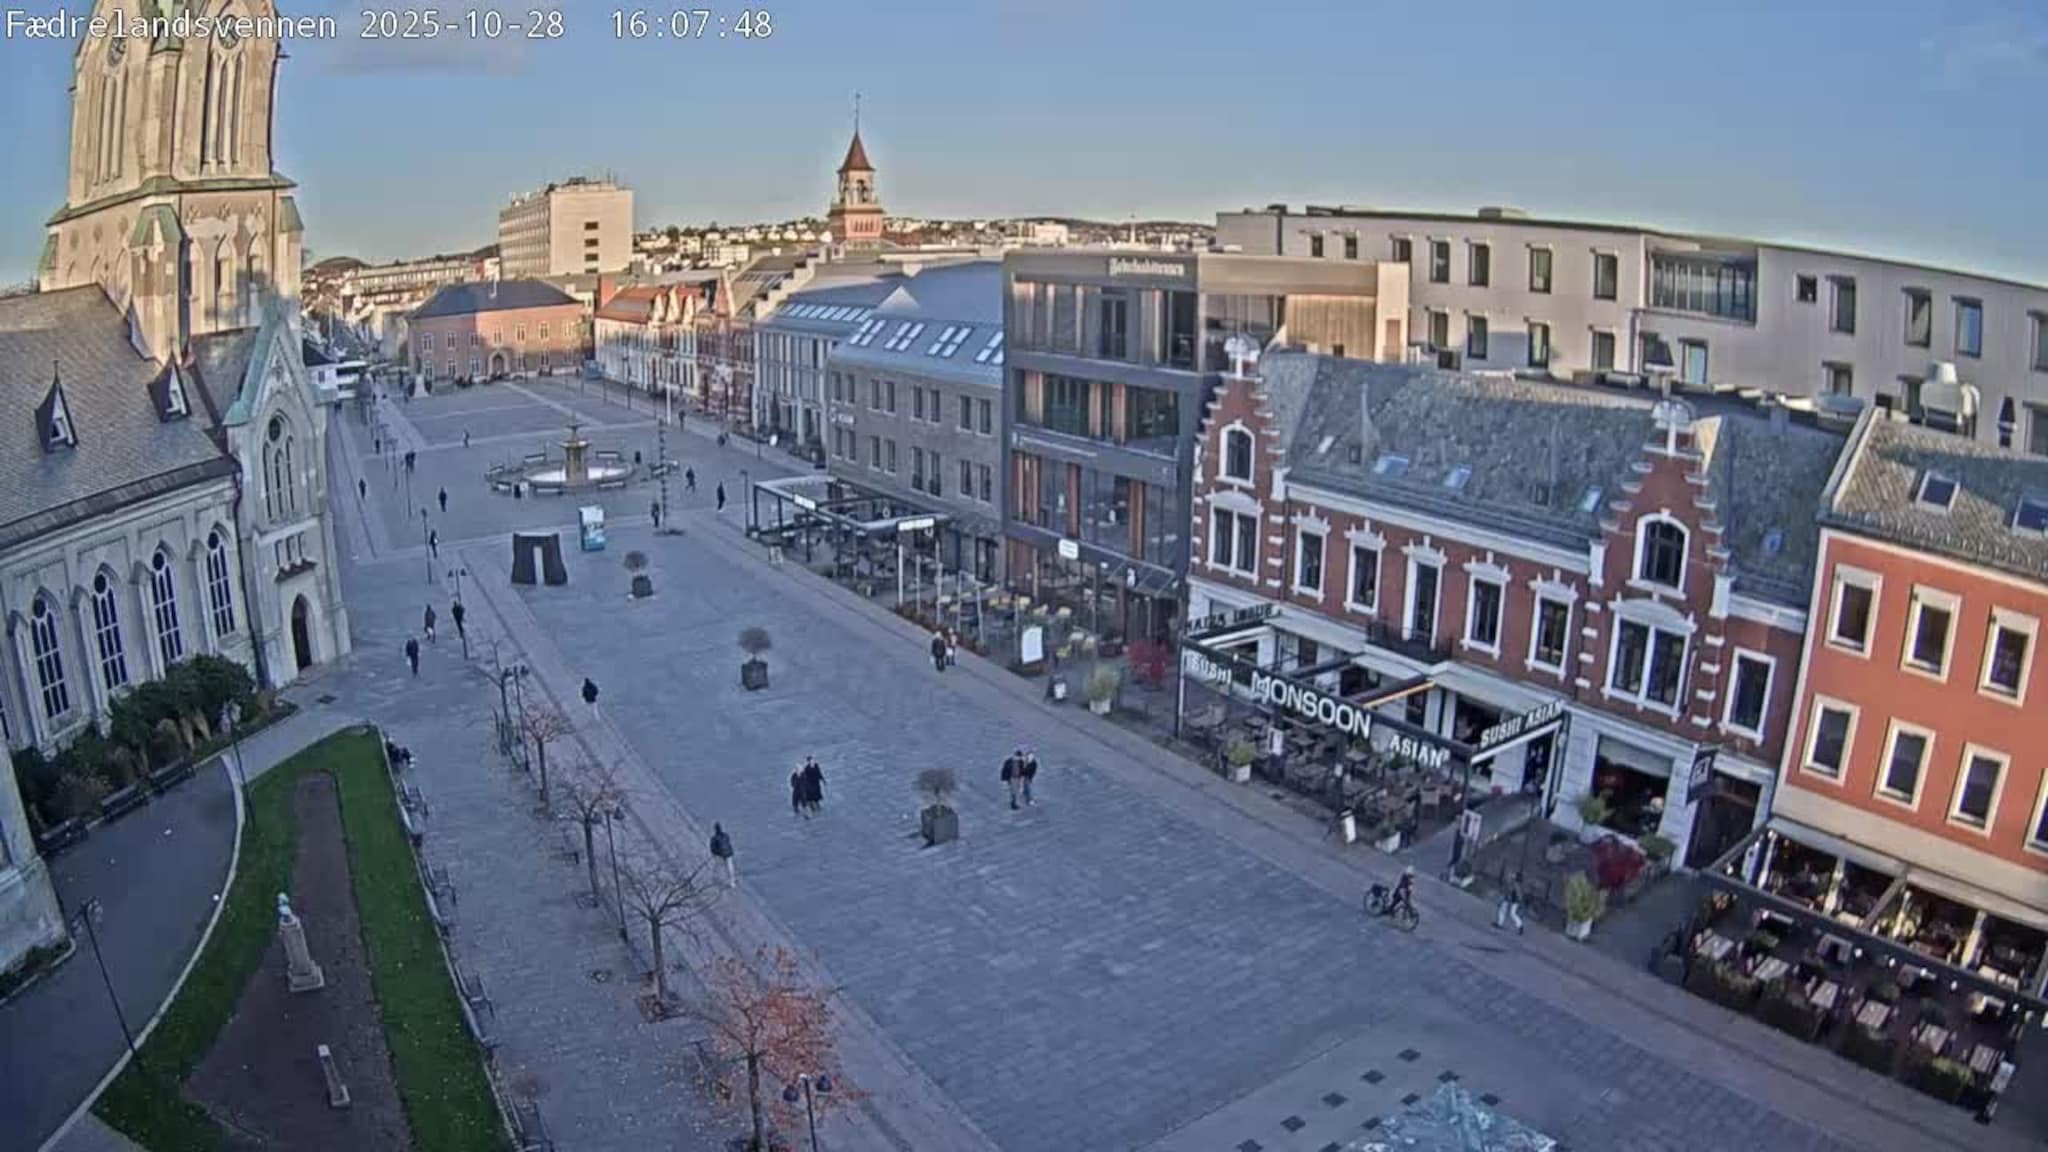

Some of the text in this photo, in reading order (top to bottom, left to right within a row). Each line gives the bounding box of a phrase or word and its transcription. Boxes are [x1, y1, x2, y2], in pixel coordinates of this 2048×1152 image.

[1250, 670, 1372, 740] MONSOON
[1390, 734, 1443, 769] ASIAN
[1479, 715, 1523, 749] SUSHI
